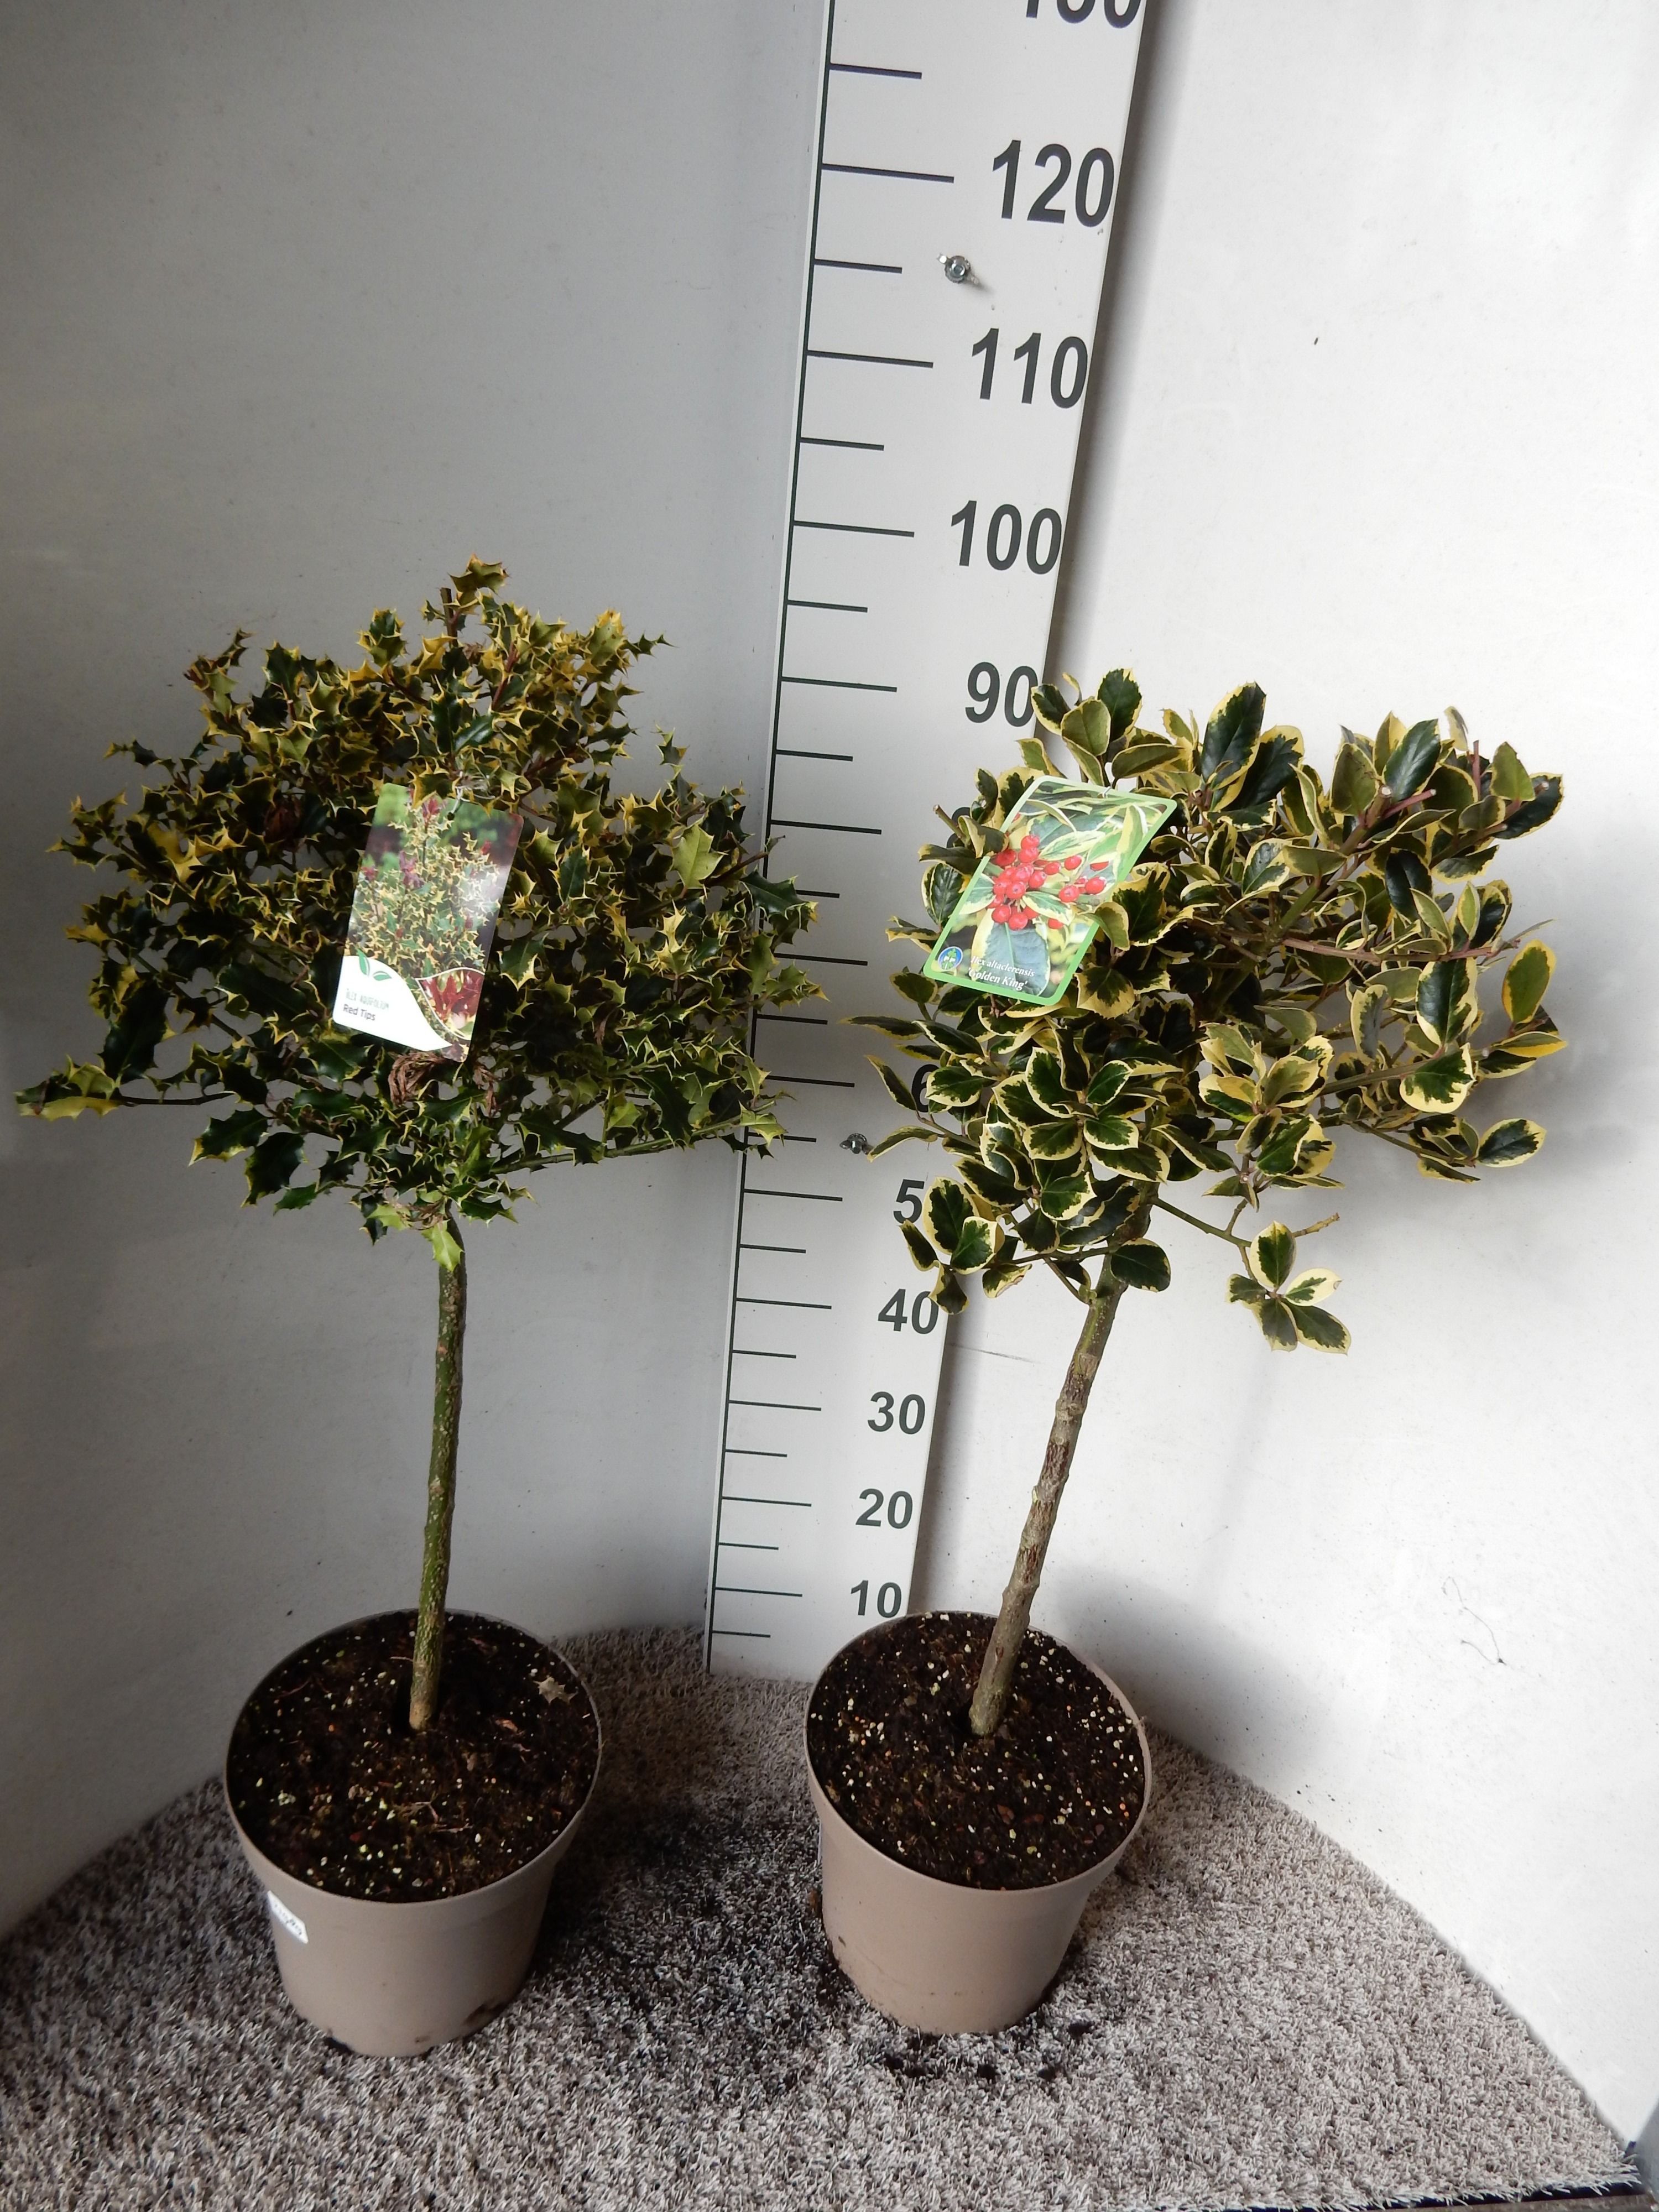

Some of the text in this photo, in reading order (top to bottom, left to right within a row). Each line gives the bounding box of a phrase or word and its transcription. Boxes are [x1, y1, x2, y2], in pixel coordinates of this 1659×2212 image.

[993, 140, 1114, 227] 120
[972, 328, 1088, 409] 110
[951, 500, 1062, 575] 100
[966, 662, 1038, 727] 90
[971, 956, 986, 966] Ilex
[1001, 976, 1028, 991] King'
[343, 1004, 375, 1021] Red Tips
[893, 1179, 925, 1223] 5
[878, 1289, 938, 1334] 40
[868, 1391, 926, 1434] 30
[855, 1489, 913, 1529] 20
[851, 1580, 902, 1618] 10
